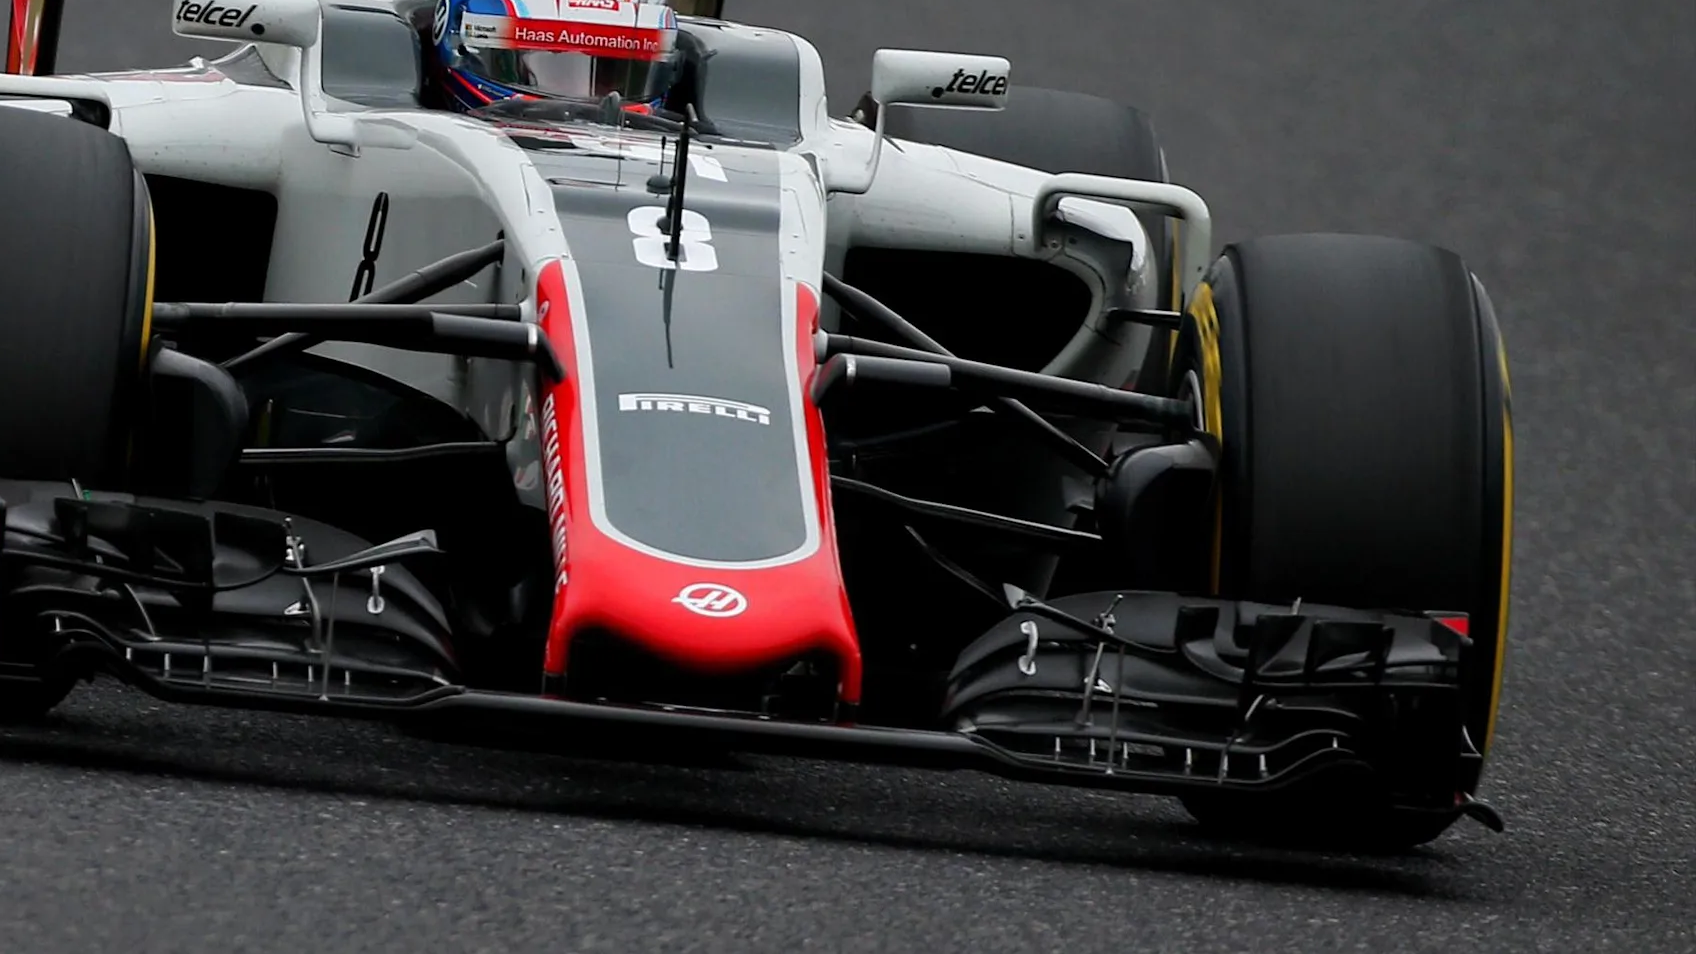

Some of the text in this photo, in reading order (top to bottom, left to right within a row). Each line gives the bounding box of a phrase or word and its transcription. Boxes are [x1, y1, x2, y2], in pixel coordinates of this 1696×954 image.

[515, 27, 554, 42] Haas
[557, 29, 640, 50] Automation
[627, 205, 719, 272] 8
[618, 393, 771, 425] PIRELLI
